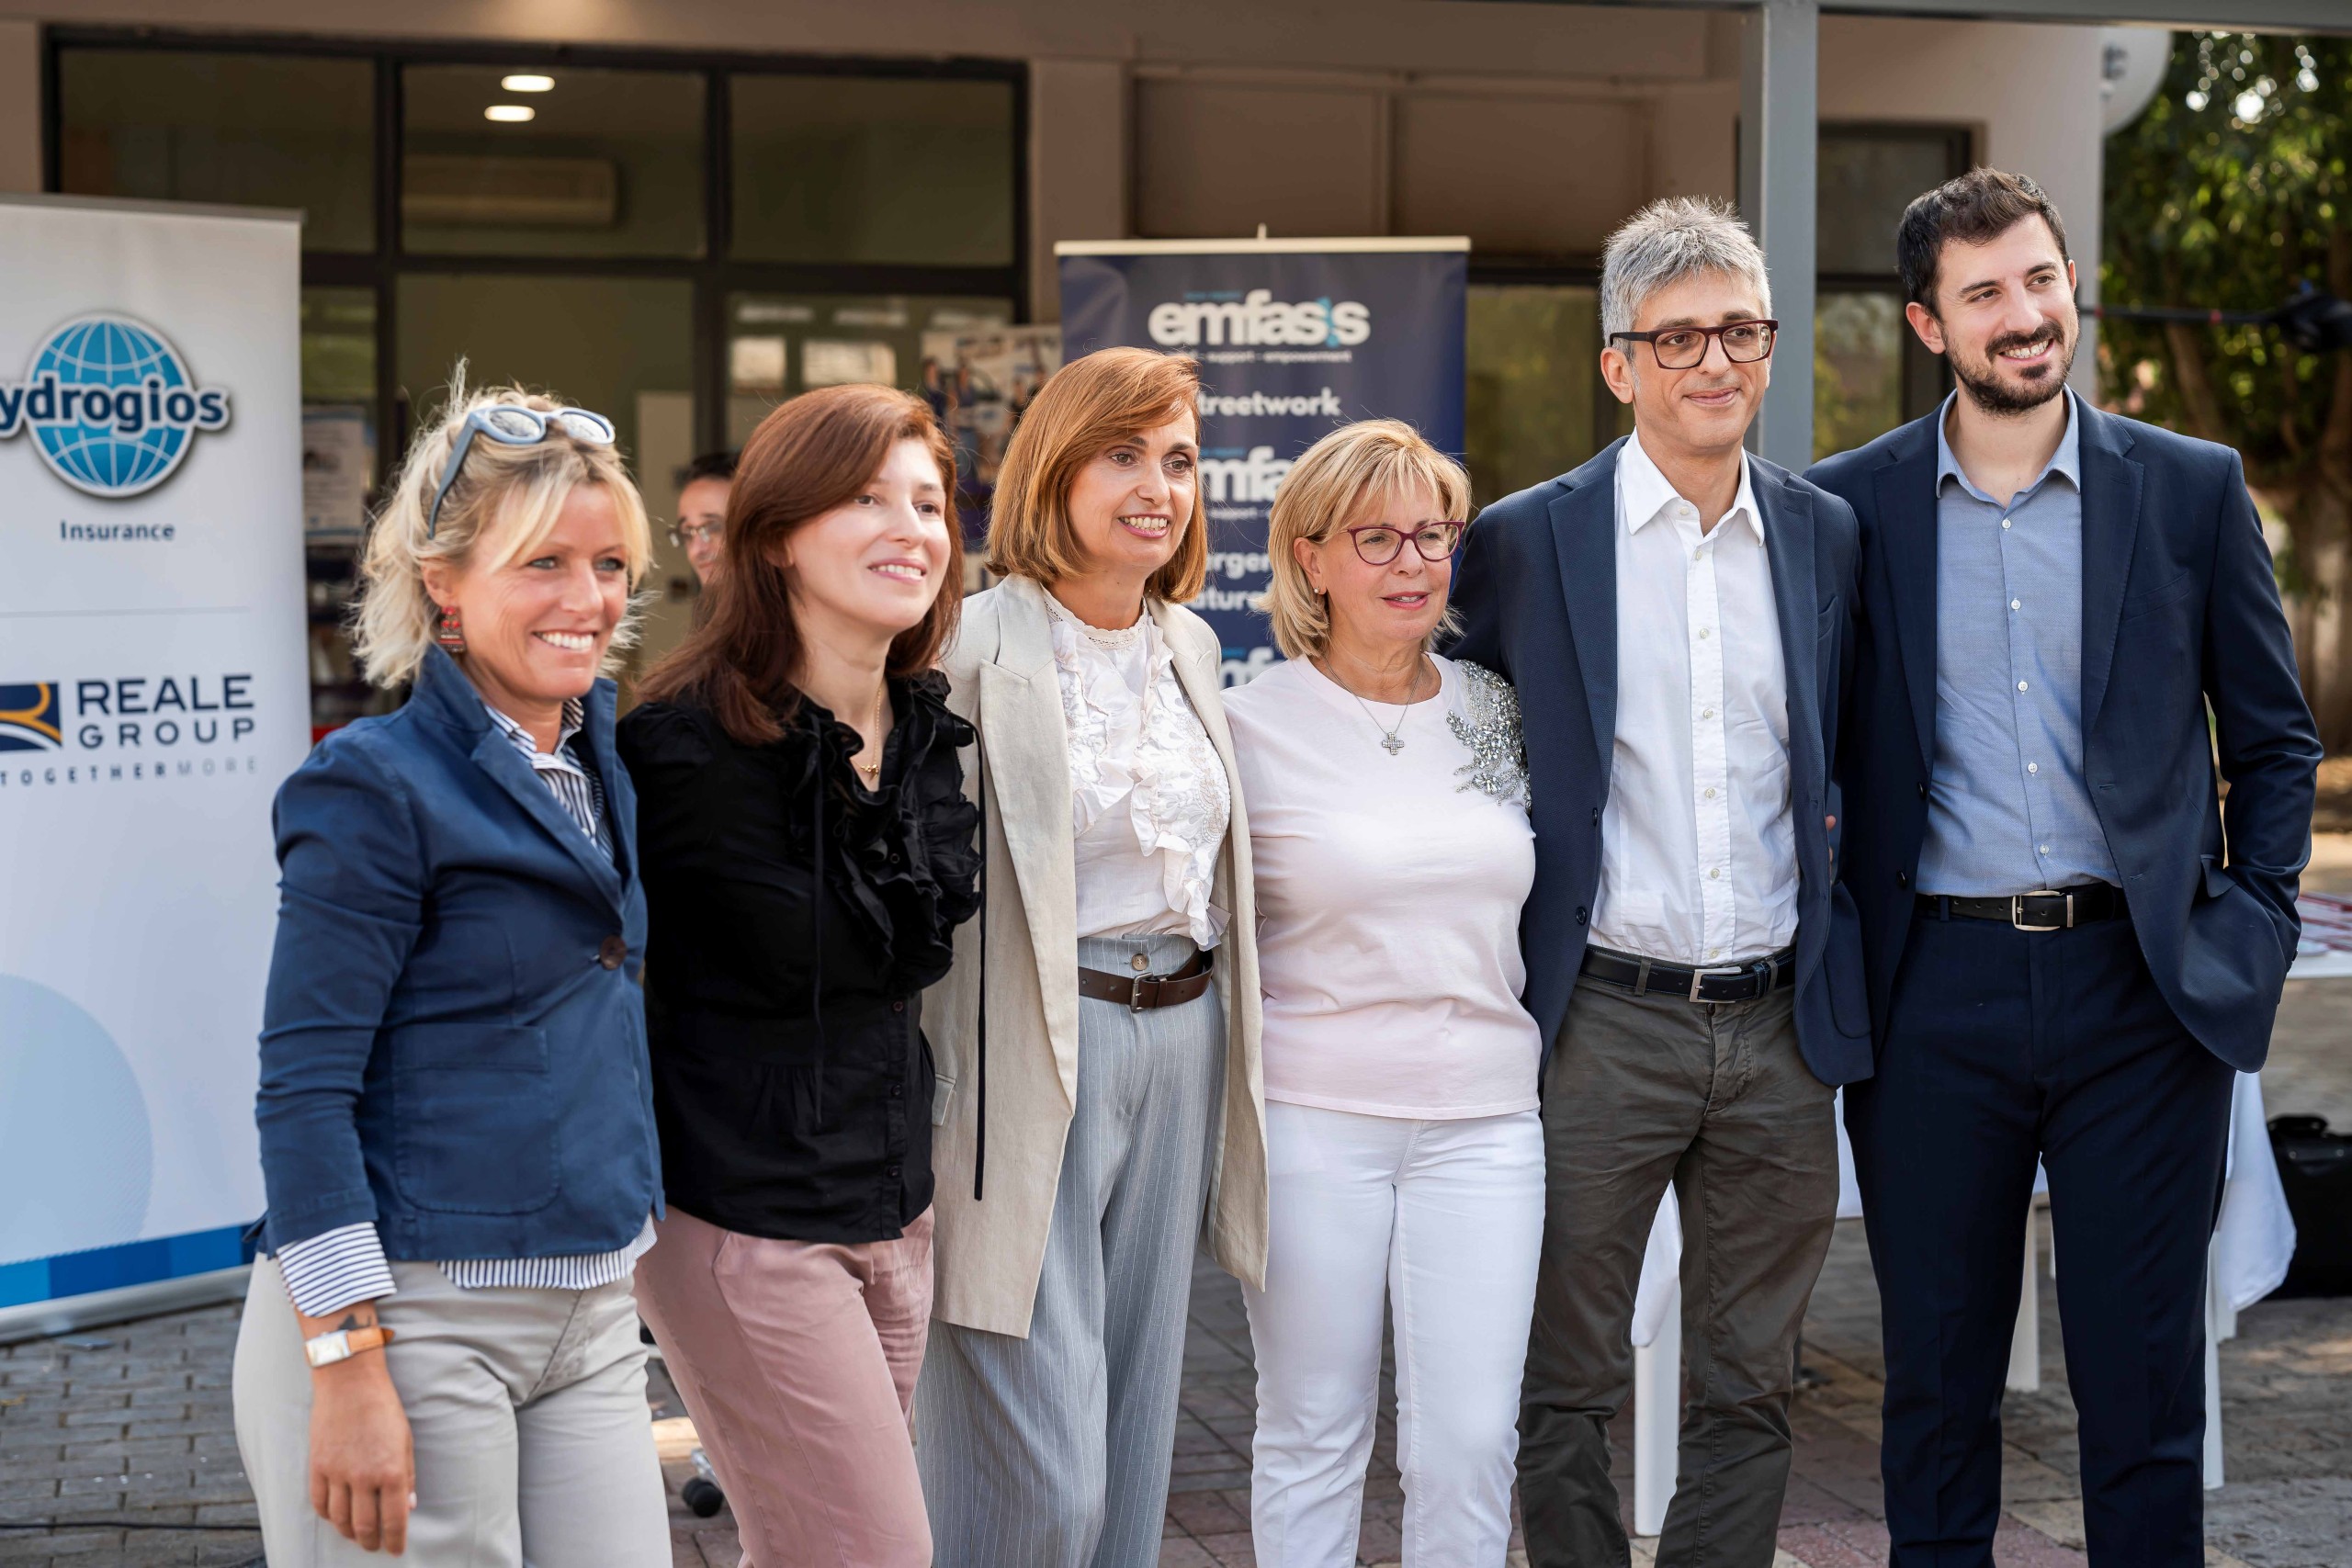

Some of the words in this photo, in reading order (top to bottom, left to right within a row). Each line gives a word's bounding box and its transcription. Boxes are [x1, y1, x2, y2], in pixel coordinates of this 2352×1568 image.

[0, 377, 223, 433] ydrogios
[1198, 387, 1341, 416] treetwork
[60, 521, 175, 540] Insurance
[77, 674, 254, 716] REALE
[79, 717, 254, 750] GROUP
